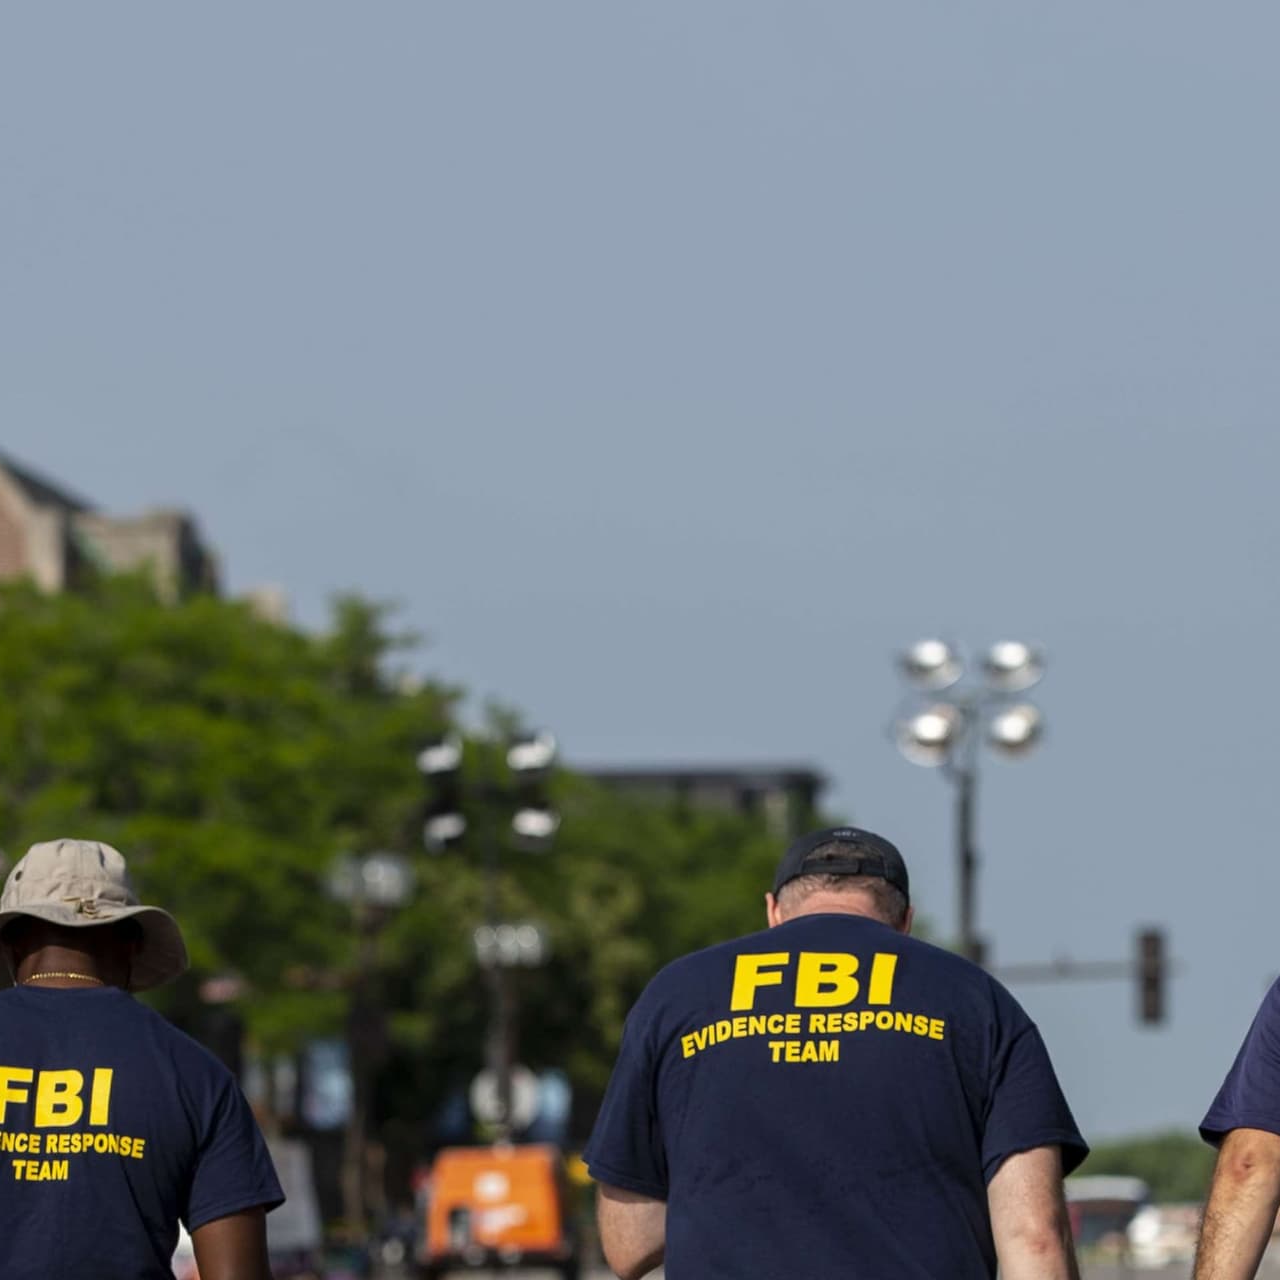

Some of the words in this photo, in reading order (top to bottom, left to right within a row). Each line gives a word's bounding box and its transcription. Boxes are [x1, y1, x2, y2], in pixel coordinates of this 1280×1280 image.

[729, 951, 898, 1012] FBI
[680, 1012, 801, 1059] EVIDENCE
[808, 1010, 945, 1041] RESPONSE
[767, 1039, 840, 1063] TEAM
[45, 1131, 146, 1159] RESPONSE
[11, 1159, 69, 1181] TEAM
